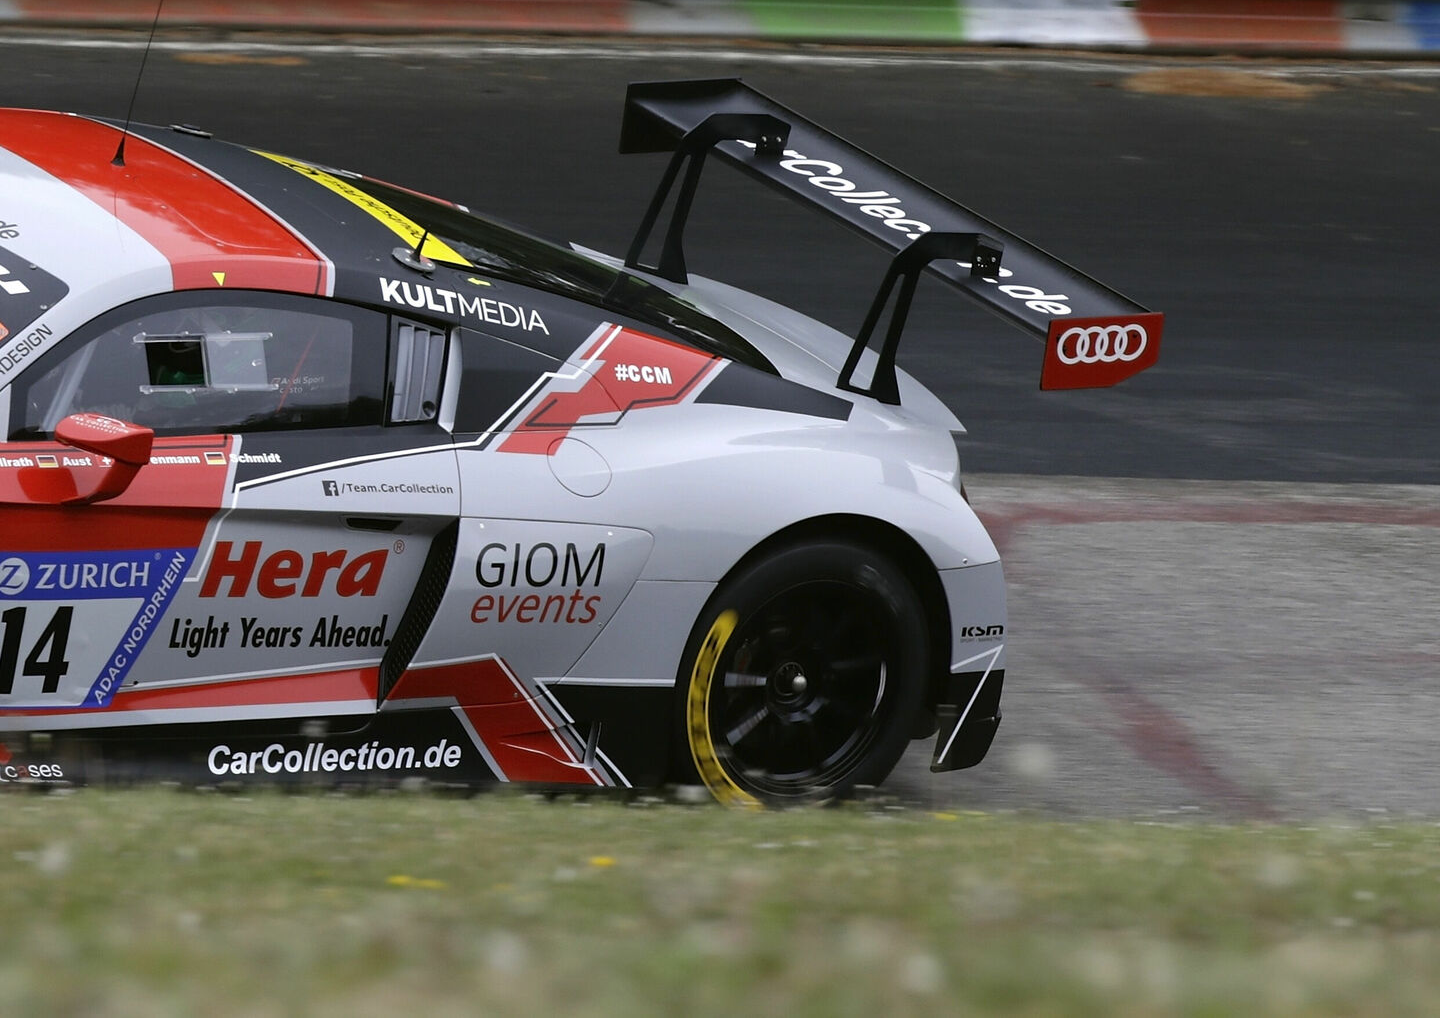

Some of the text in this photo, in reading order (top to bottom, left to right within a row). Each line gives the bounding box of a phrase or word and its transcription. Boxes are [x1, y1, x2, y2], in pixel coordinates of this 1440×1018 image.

[379, 277, 550, 335] KULTMEDIA
[614, 363, 673, 385] #CCM
[62, 455, 93, 467] Aust
[149, 456, 201, 464] enmann
[229, 452, 282, 464] Schmidt
[34, 562, 151, 590] ZURICH
[198, 541, 389, 599] Hera
[475, 542, 606, 588] GIOM
[470, 589, 602, 624] events
[94, 551, 187, 705] ADAC NORDRHEIN
[169, 614, 392, 658] Light Years Ahead.
[207, 739, 462, 775] CarCollection.de
